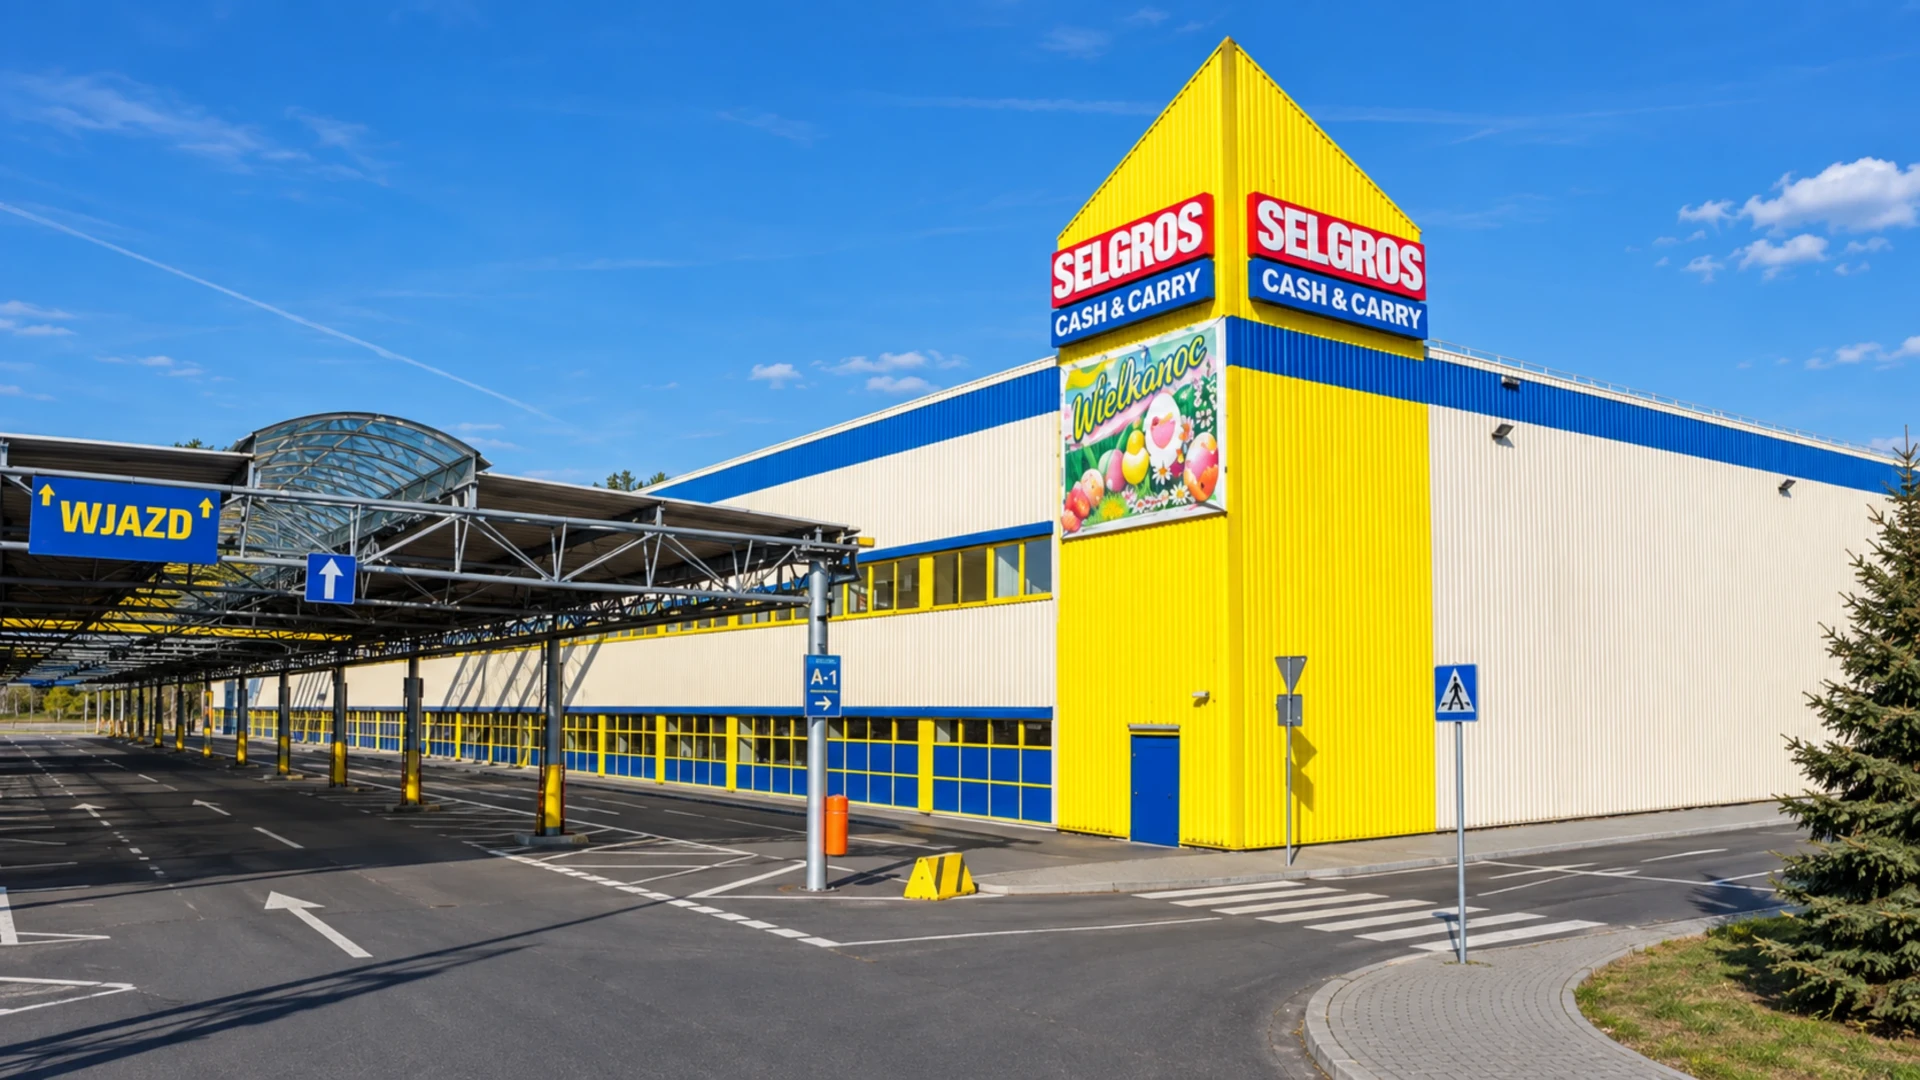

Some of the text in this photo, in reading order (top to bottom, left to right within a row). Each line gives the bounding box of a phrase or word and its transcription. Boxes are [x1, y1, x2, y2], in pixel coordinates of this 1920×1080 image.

[1053, 201, 1203, 299] SELGROS
[1257, 200, 1423, 291] SELGROS
[1055, 268, 1201, 337] CASH & CARRY
[1262, 268, 1422, 330] CASH & CARRY
[1073, 335, 1207, 442] Wielkanoc
[60, 500, 193, 540] WJAZD
[810, 668, 837, 685] A-1
